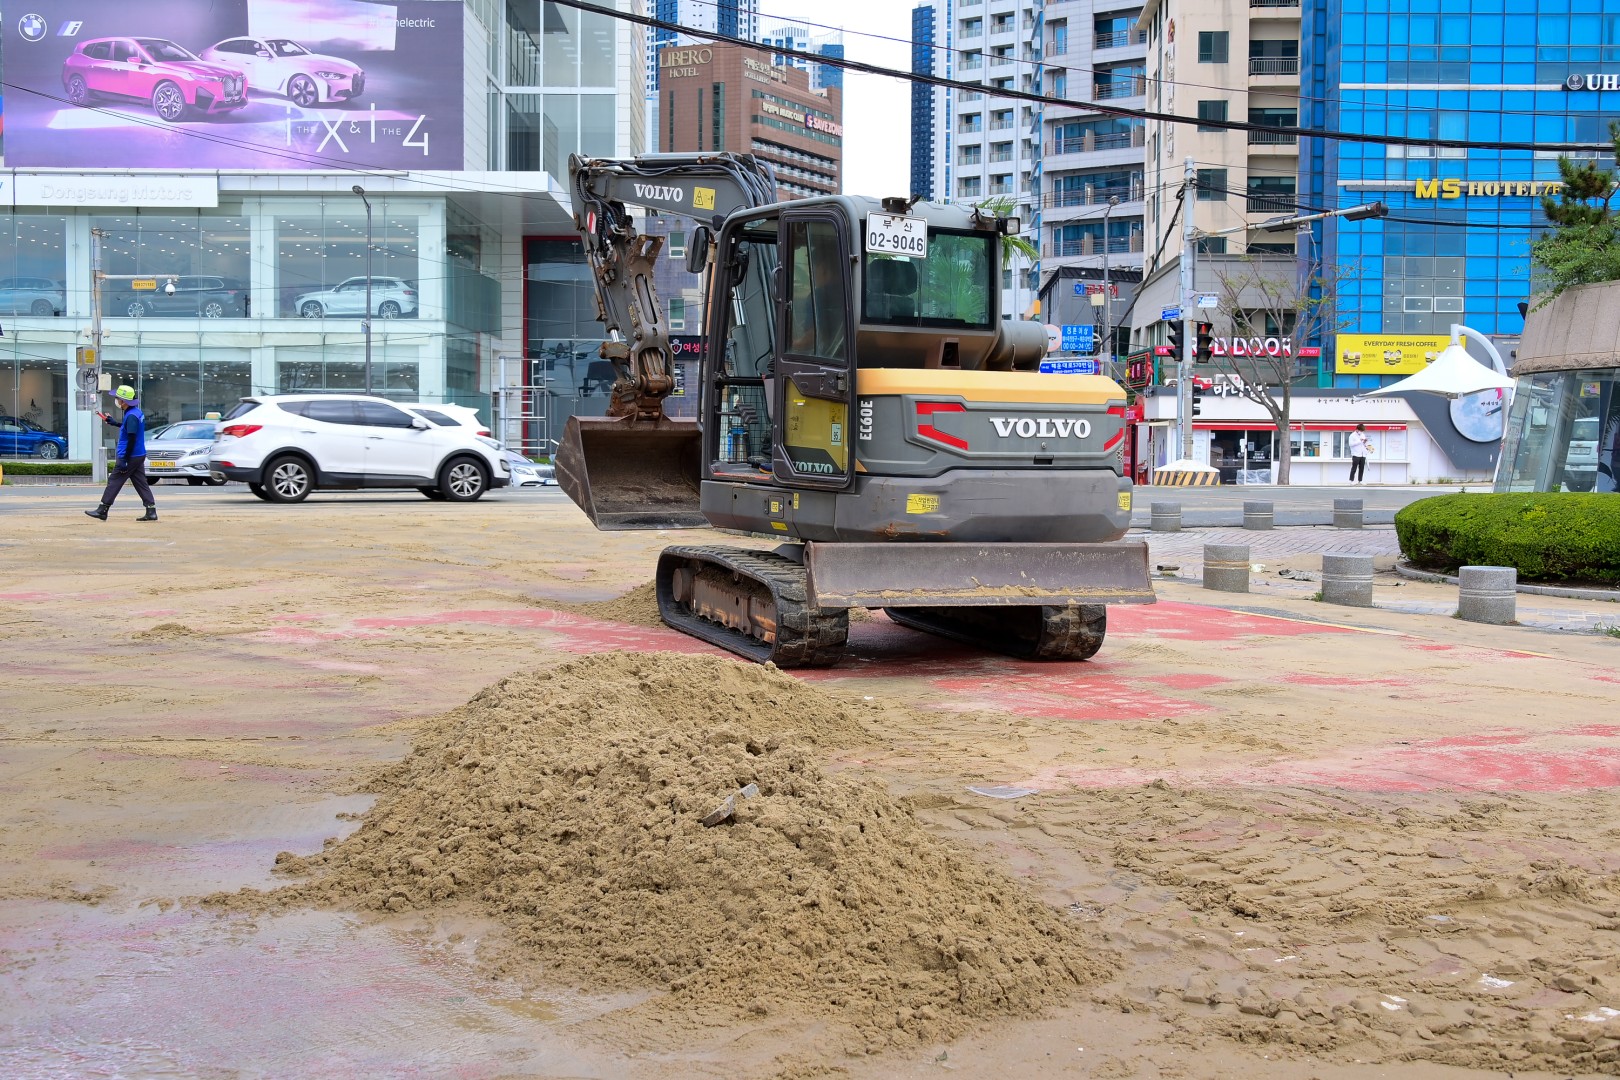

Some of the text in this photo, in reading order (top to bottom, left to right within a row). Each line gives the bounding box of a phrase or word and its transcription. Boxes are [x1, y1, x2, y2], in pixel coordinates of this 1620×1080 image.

[660, 48, 713, 68] LIBERO
[669, 67, 700, 78] HOTEL
[1586, 74, 1620, 91] UH
[41, 185, 193, 203] Dongsung Motors
[633, 183, 684, 203] VOLVO
[1415, 178, 1461, 199] MS
[1467, 181, 1542, 197] HOTEL
[870, 231, 924, 252] 02-9046
[1233, 337, 1292, 356] DOOR
[860, 400, 873, 441] EC60E
[988, 417, 1092, 439] VOLVO
[795, 461, 834, 474] VOLVO
